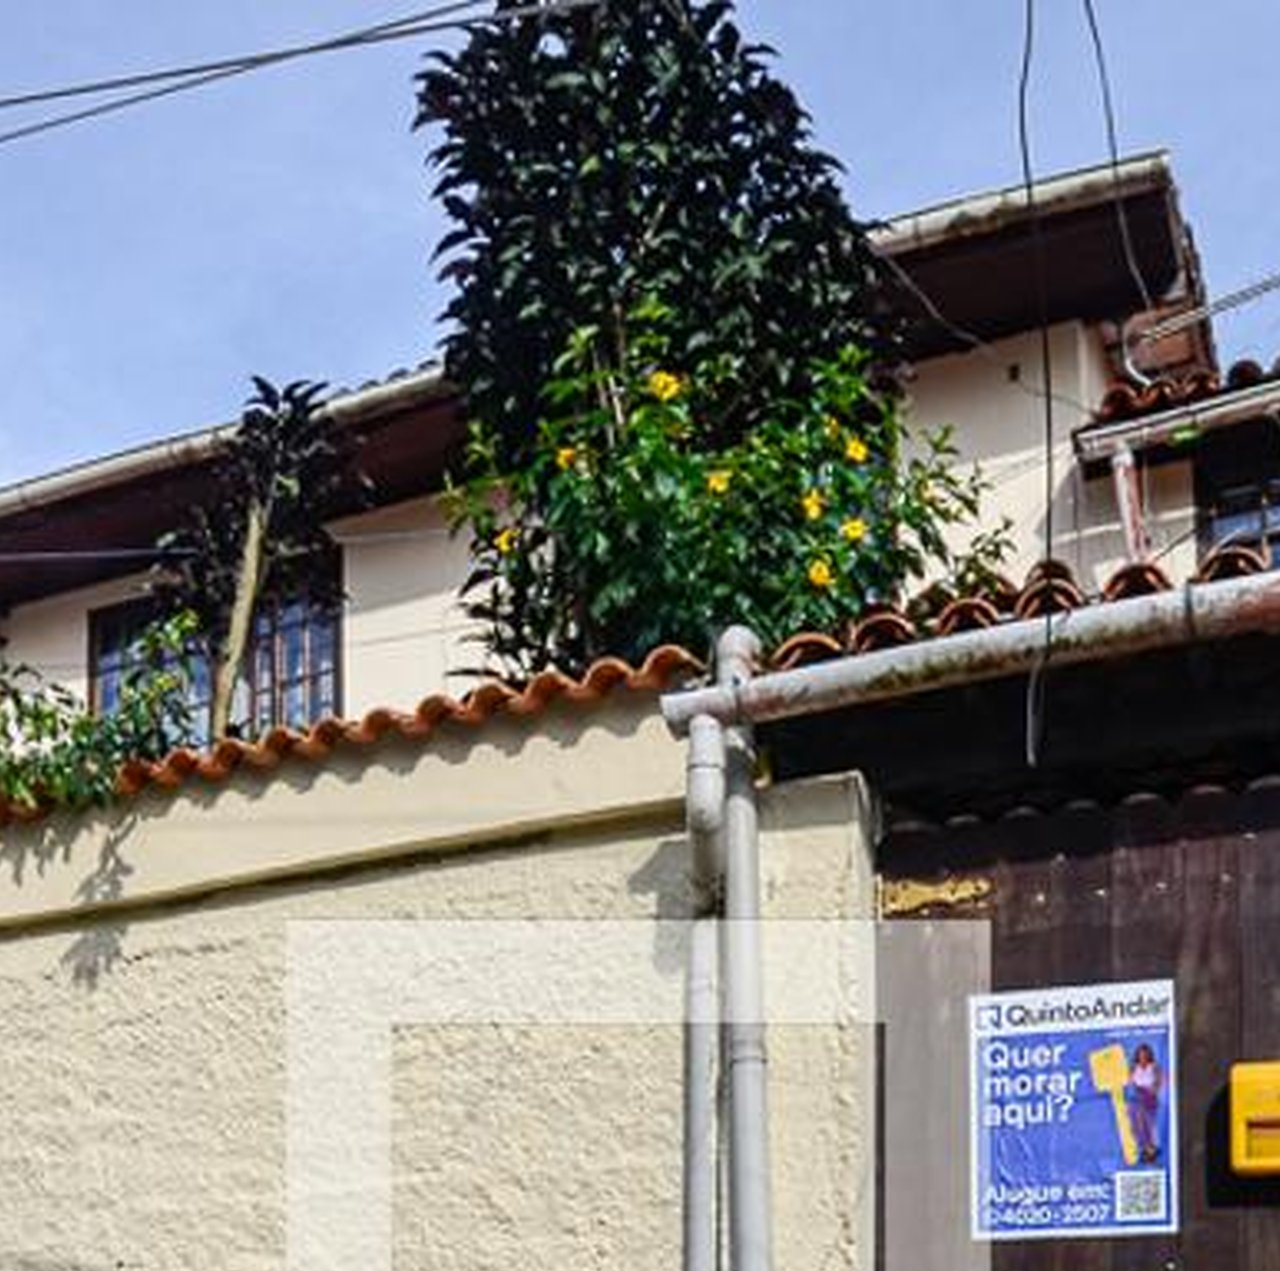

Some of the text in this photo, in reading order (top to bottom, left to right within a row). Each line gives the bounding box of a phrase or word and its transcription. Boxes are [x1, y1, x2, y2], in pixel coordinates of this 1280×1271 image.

[983, 1042, 1068, 1069] Quer
[983, 1072, 1082, 1097] morar
[983, 1095, 1074, 1130] aqui?
